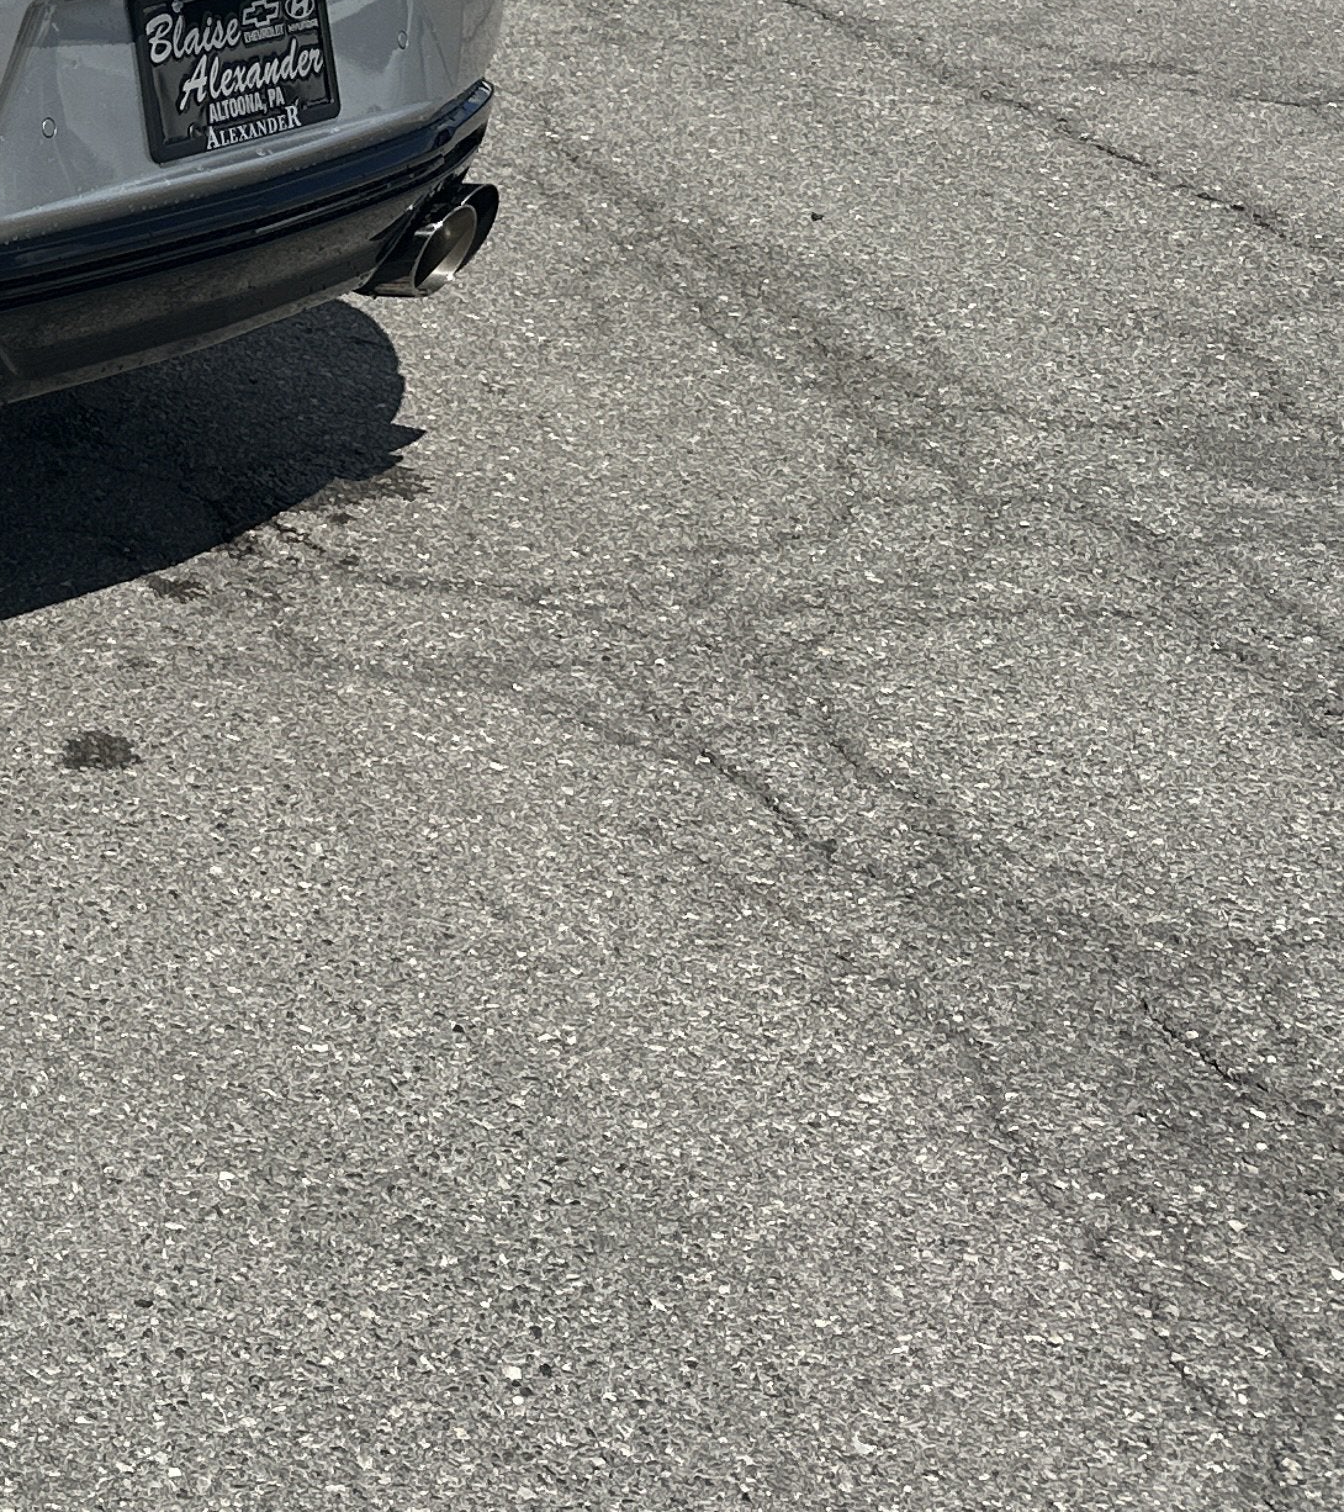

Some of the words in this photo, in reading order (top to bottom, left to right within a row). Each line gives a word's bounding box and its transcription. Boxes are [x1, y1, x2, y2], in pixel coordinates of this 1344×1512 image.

[146, 13, 241, 63] Blaise
[244, 24, 285, 43] CHEVROLET
[180, 38, 323, 111] Alexander
[209, 92, 267, 123] ALTOONA,
[268, 86, 285, 108] PA
[207, 105, 302, 150] ALEXANDER
